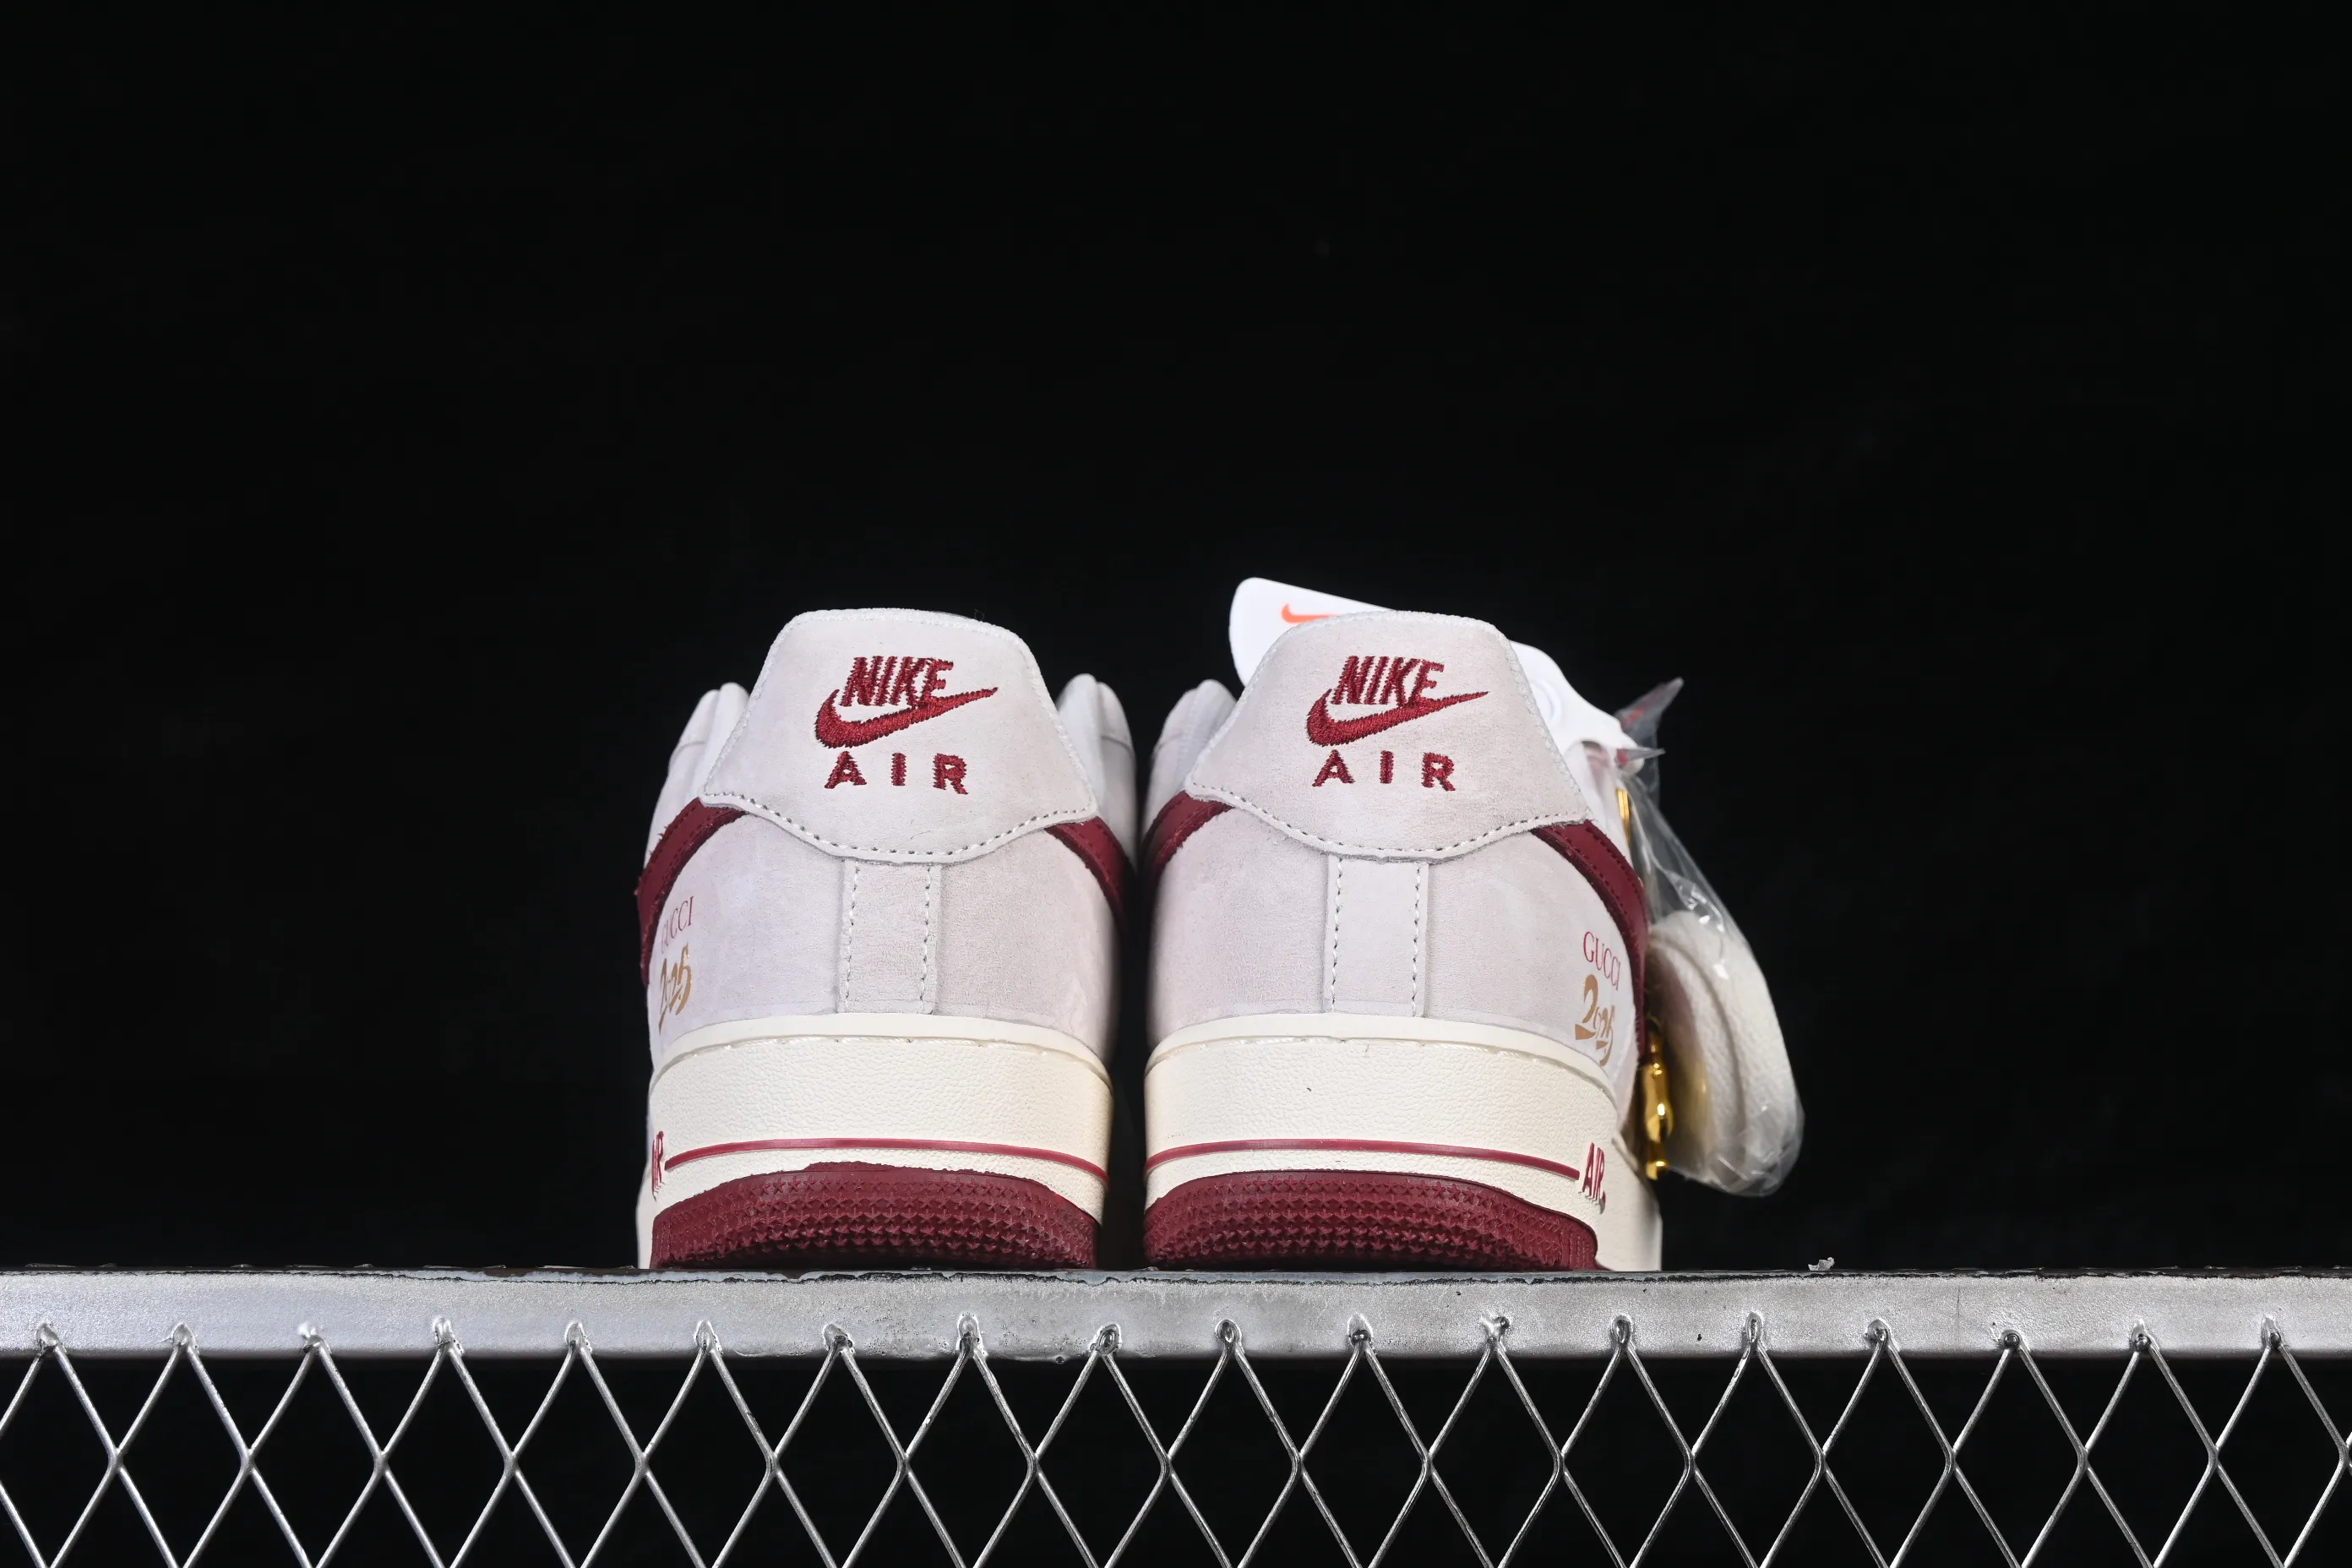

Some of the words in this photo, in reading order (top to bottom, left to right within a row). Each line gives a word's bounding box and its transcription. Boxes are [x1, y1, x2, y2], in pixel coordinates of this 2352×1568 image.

[839, 656, 954, 710] NIKE
[1331, 656, 1445, 708] NIKE
[824, 750, 969, 795] AIR
[1311, 749, 1456, 792] AIR
[1583, 931, 1621, 990] GUCCI
